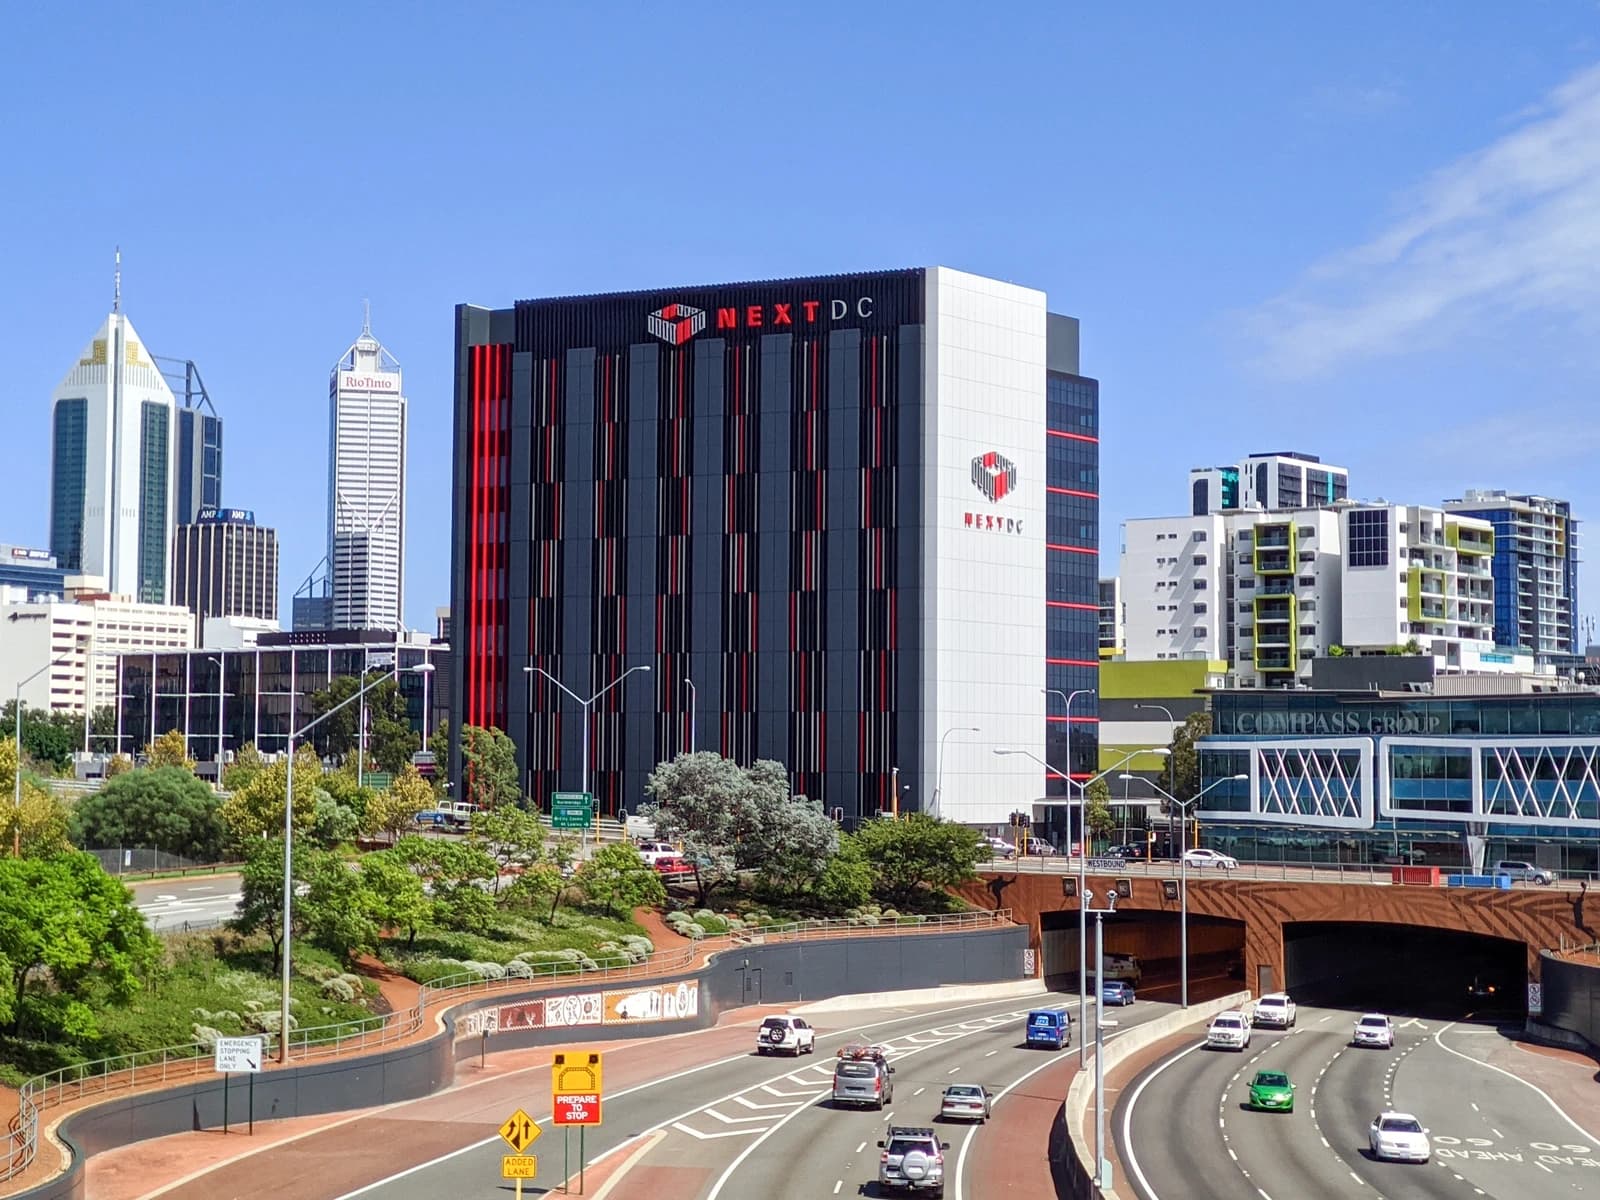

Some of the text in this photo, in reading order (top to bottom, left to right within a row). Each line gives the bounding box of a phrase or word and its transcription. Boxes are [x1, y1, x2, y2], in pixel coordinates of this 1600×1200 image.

[200, 510, 217, 519] AMP
[231, 510, 245, 520] AMP
[1236, 712, 1440, 734] COMPASS GROUP
[1087, 859, 1126, 868] WESTBOUND
[556, 1095, 598, 1104] PREPARE
[571, 1103, 583, 1112] TO
[566, 1111, 589, 1120] STOP
[1435, 1148, 1524, 1163] AHEAD
[505, 1158, 533, 1166] ADDED
[507, 1168, 529, 1176] LANE
